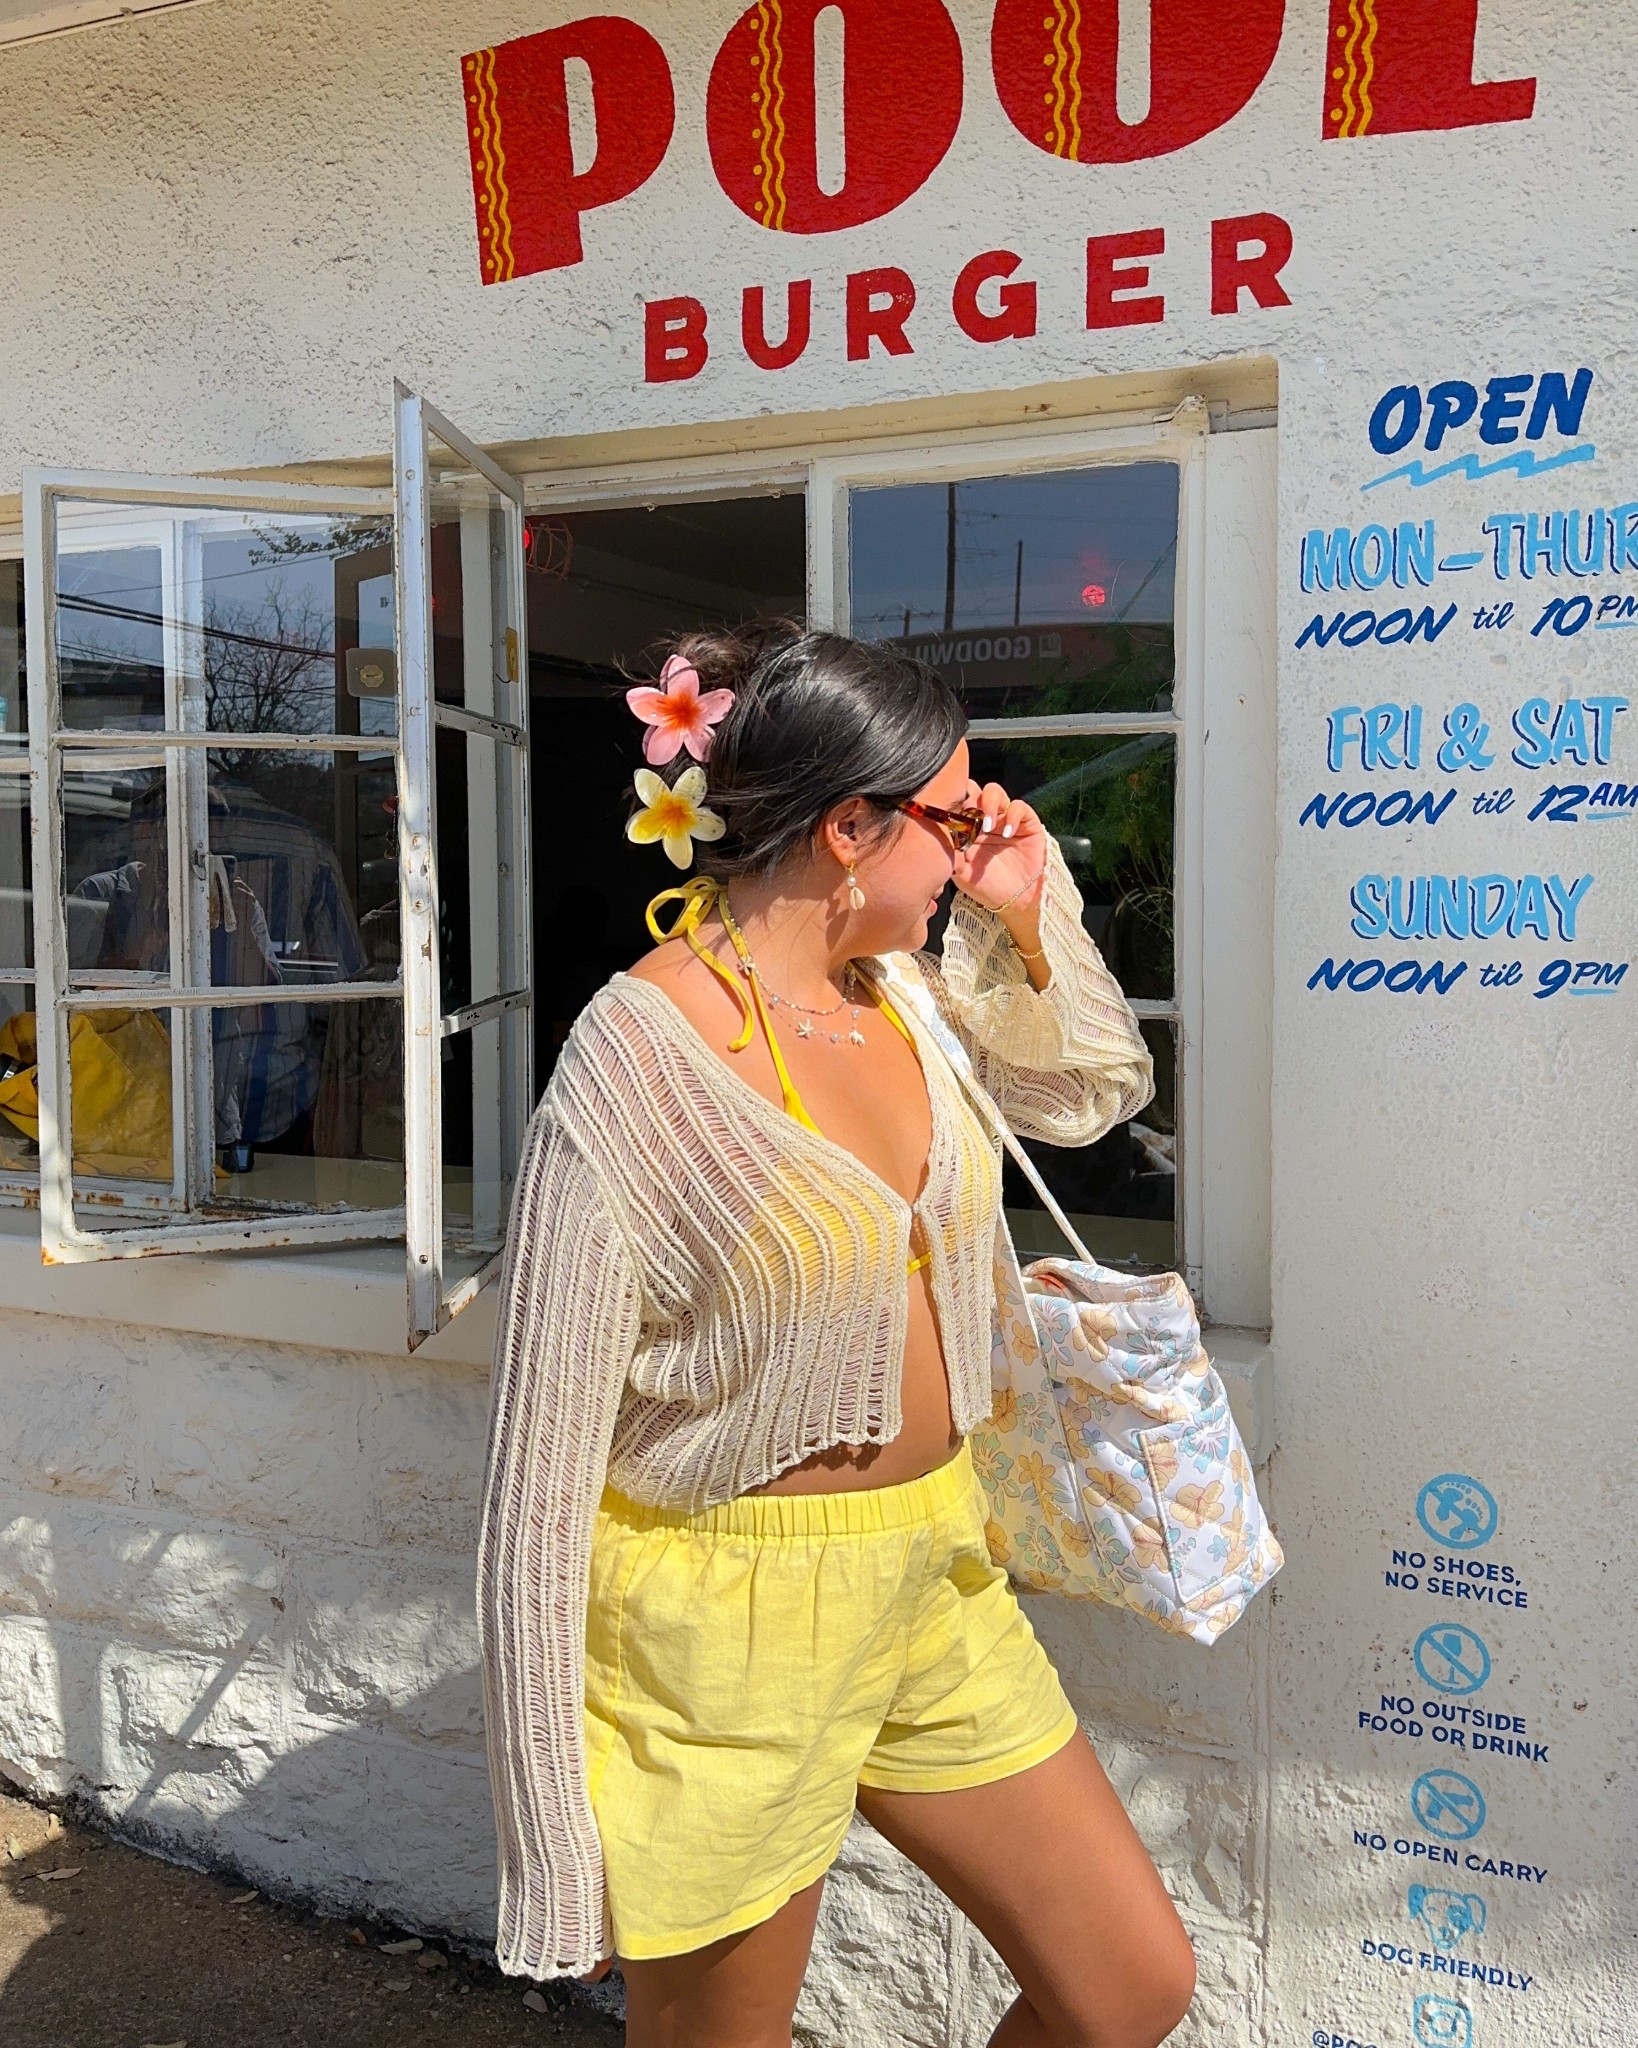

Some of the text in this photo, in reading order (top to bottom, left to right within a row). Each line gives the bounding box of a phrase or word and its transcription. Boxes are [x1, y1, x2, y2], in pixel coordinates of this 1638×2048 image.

[462, 0, 1537, 285] POOL
[646, 214, 1293, 382] BURGER
[1369, 368, 1594, 456] OPEN
[1295, 603, 1457, 649] NOON
[1473, 602, 1513, 630] til
[1327, 696, 1630, 774] FRI & SAT
[1299, 788, 1457, 829] NOON
[1473, 788, 1514, 815] til
[1350, 873, 1595, 942] SUNDAY
[1306, 958, 1468, 995] NOON
[1480, 961, 1523, 987] til
[1385, 1572, 1528, 1608] NO SERVICE
[1392, 1550, 1521, 1587] NO SHOES,
[1358, 1711, 1549, 1763] FOOD OR DRINK
[1381, 1695, 1526, 1734] NO OUTSIDE
[1354, 1830, 1548, 1884] NO OPEN CARRY
[1361, 1939, 1533, 1992] DOG FRIENDLY
